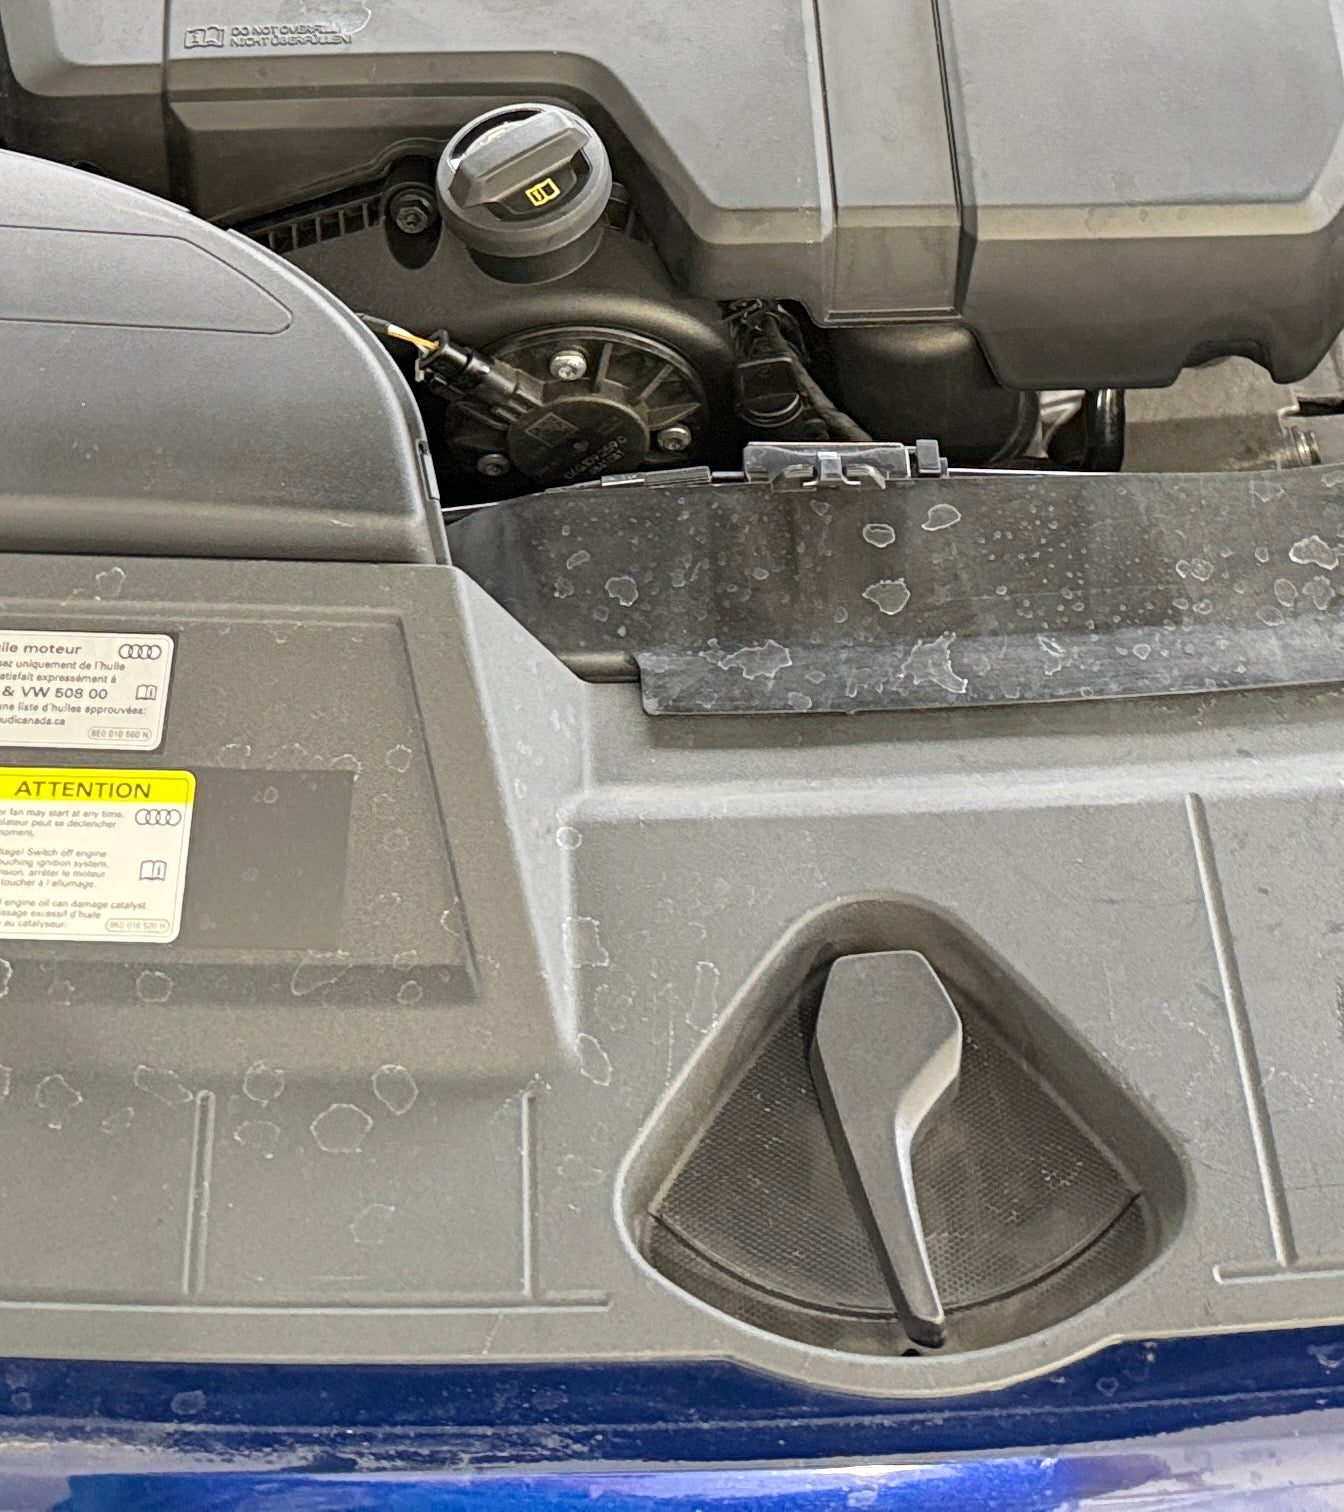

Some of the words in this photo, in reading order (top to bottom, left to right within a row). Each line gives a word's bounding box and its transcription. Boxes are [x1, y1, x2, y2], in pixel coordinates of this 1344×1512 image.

[232, 26, 249, 36] DO
[252, 25, 278, 35] NOT
[230, 37, 270, 48] NICHT
[23, 643, 82, 655] moteur
[16, 659, 76, 671] uniquement
[79, 660, 92, 670] de
[2, 685, 15, 697] &
[22, 686, 51, 698] VW
[54, 687, 84, 699] 508
[88, 688, 108, 700] 00
[17, 701, 39, 712] liste
[14, 781, 151, 798] ATTENTION
[10, 808, 23, 816] fan
[26, 809, 46, 819] may
[49, 809, 69, 817] start
[72, 810, 81, 818] at
[83, 811, 99, 820] any
[54, 820, 64, 828] se
[27, 848, 58, 857] Switch
[61, 848, 74, 857] off
[76, 850, 107, 859] engine
[37, 859, 71, 868] ignition
[73, 870, 106, 878] moteur
[0, 879, 35, 887] toucher
[4, 899, 36, 908] engine
[39, 899, 50, 907] oil
[71, 900, 108, 910] damage
